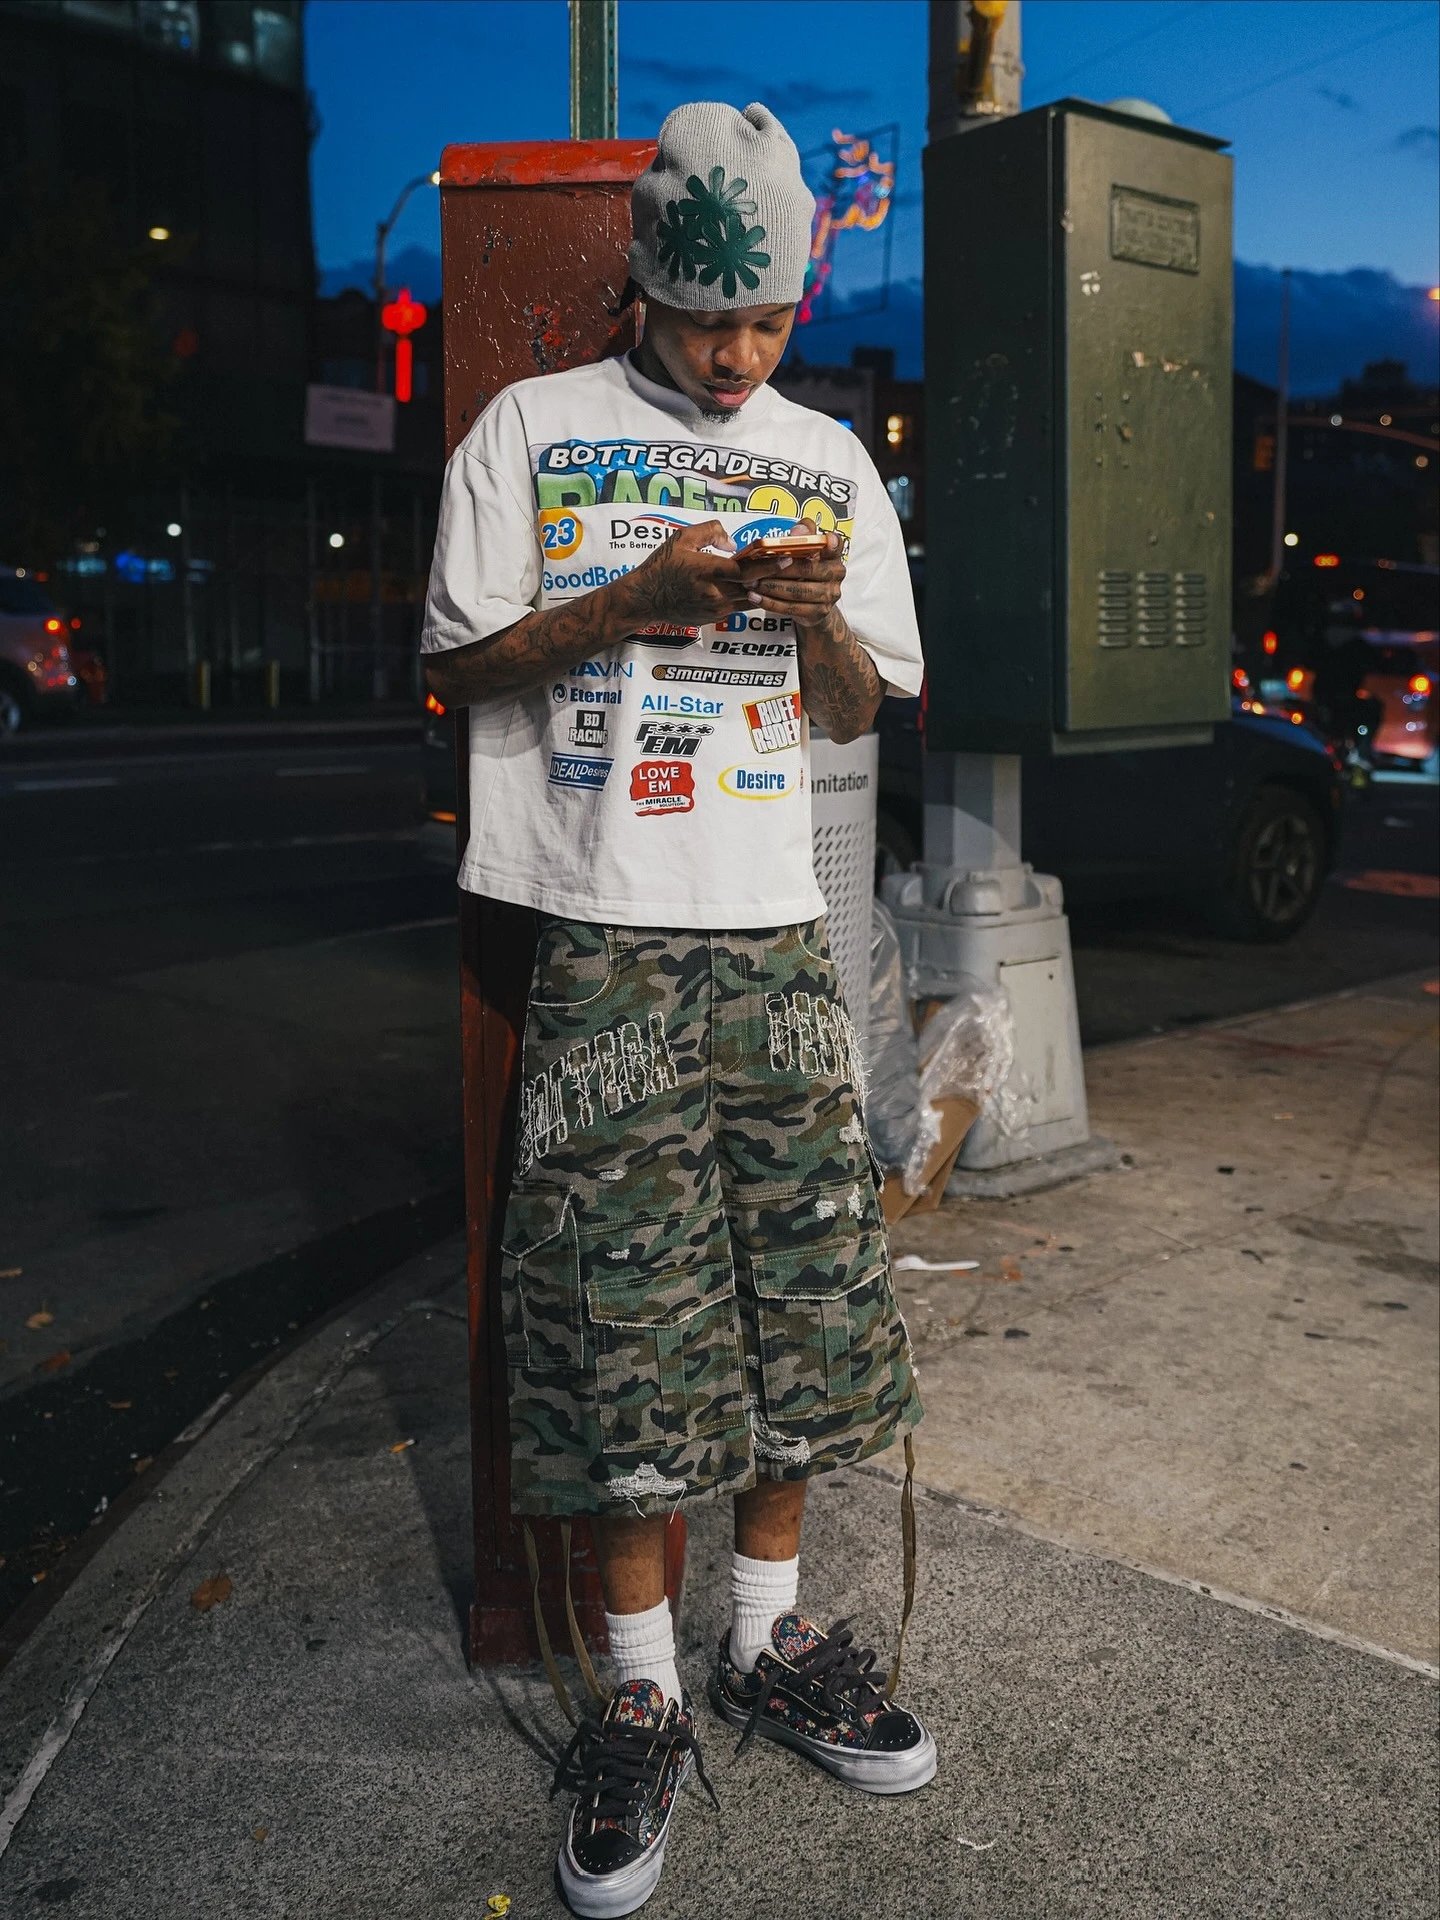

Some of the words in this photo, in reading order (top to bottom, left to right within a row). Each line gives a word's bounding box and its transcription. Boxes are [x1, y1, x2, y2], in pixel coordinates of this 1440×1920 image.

[548, 443, 718, 473] BOTTEGA
[724, 452, 851, 504] DESIRES
[542, 517, 576, 549] 23
[609, 541, 626, 549] The
[629, 540, 657, 549] Better
[664, 665, 785, 687] SmartDesires
[570, 686, 622, 705] Eternal
[641, 694, 724, 714] All-Star
[583, 713, 600, 727] BD
[755, 695, 796, 727] RUFF
[568, 727, 608, 745] RACING
[641, 735, 701, 756] EM
[640, 766, 680, 780] LOVE
[736, 769, 785, 790] Desire
[648, 780, 671, 793] EM
[645, 796, 682, 806] MIRACLE
